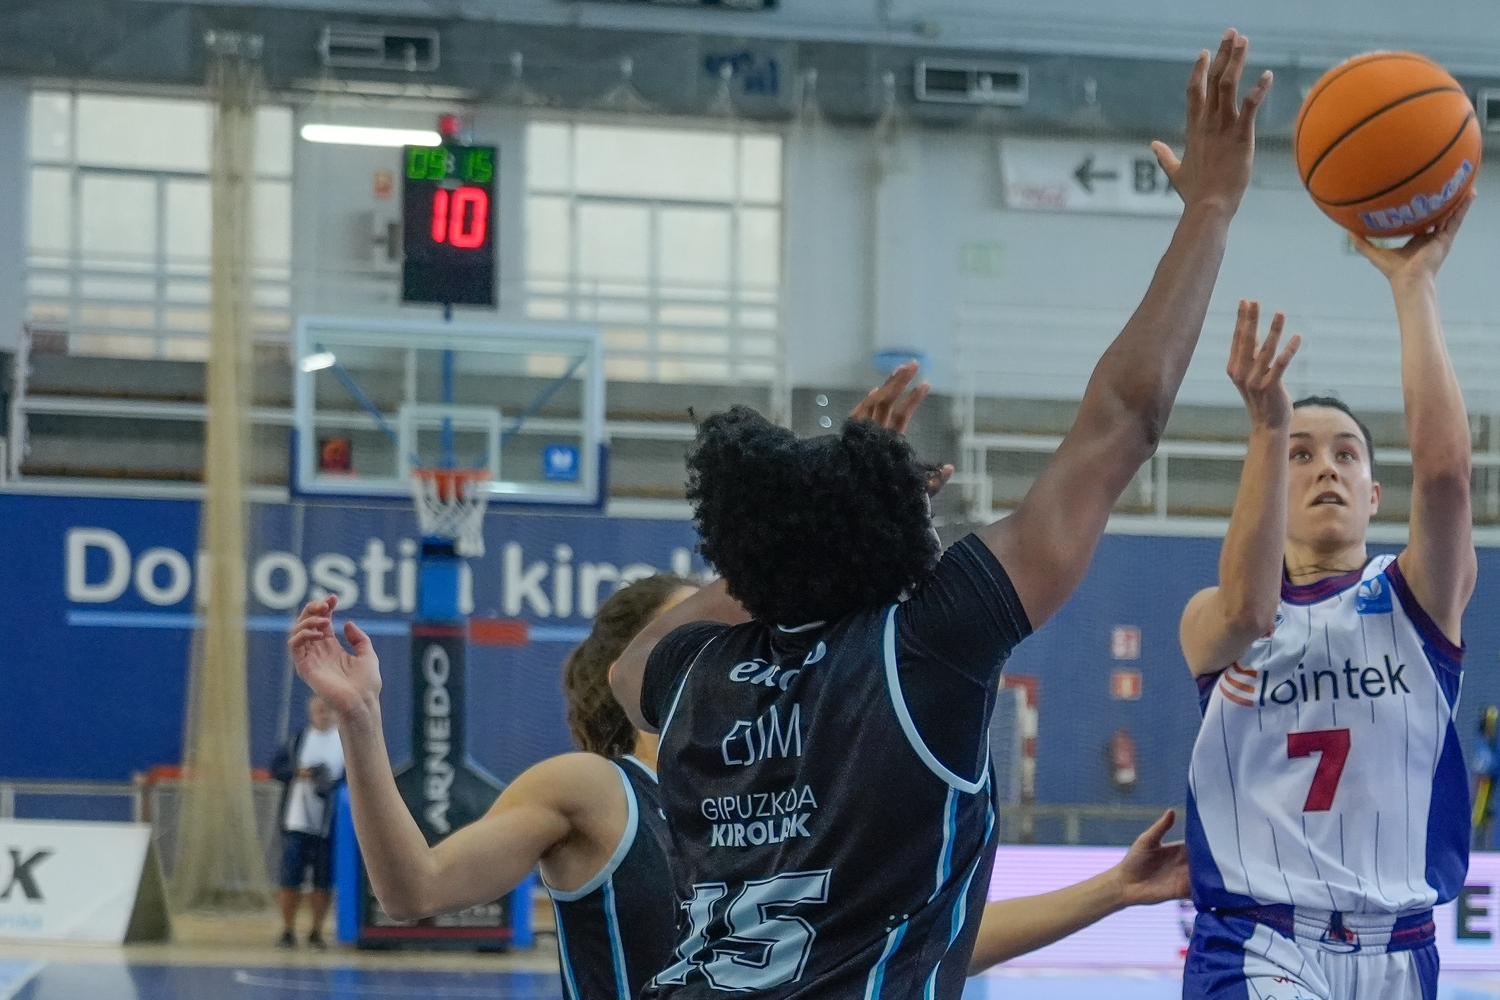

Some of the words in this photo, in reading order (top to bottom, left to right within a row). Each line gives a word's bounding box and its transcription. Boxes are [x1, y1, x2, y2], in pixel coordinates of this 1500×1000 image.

[432, 186, 488, 248] 10
[1259, 655, 1411, 706] lointek
[422, 643, 456, 834] ARNEDO
[721, 703, 802, 766] EJIM
[1287, 728, 1351, 813] 7
[701, 784, 818, 820] GIPUZKOA
[711, 812, 811, 847] KIROLAK
[651, 868, 833, 991] 15
